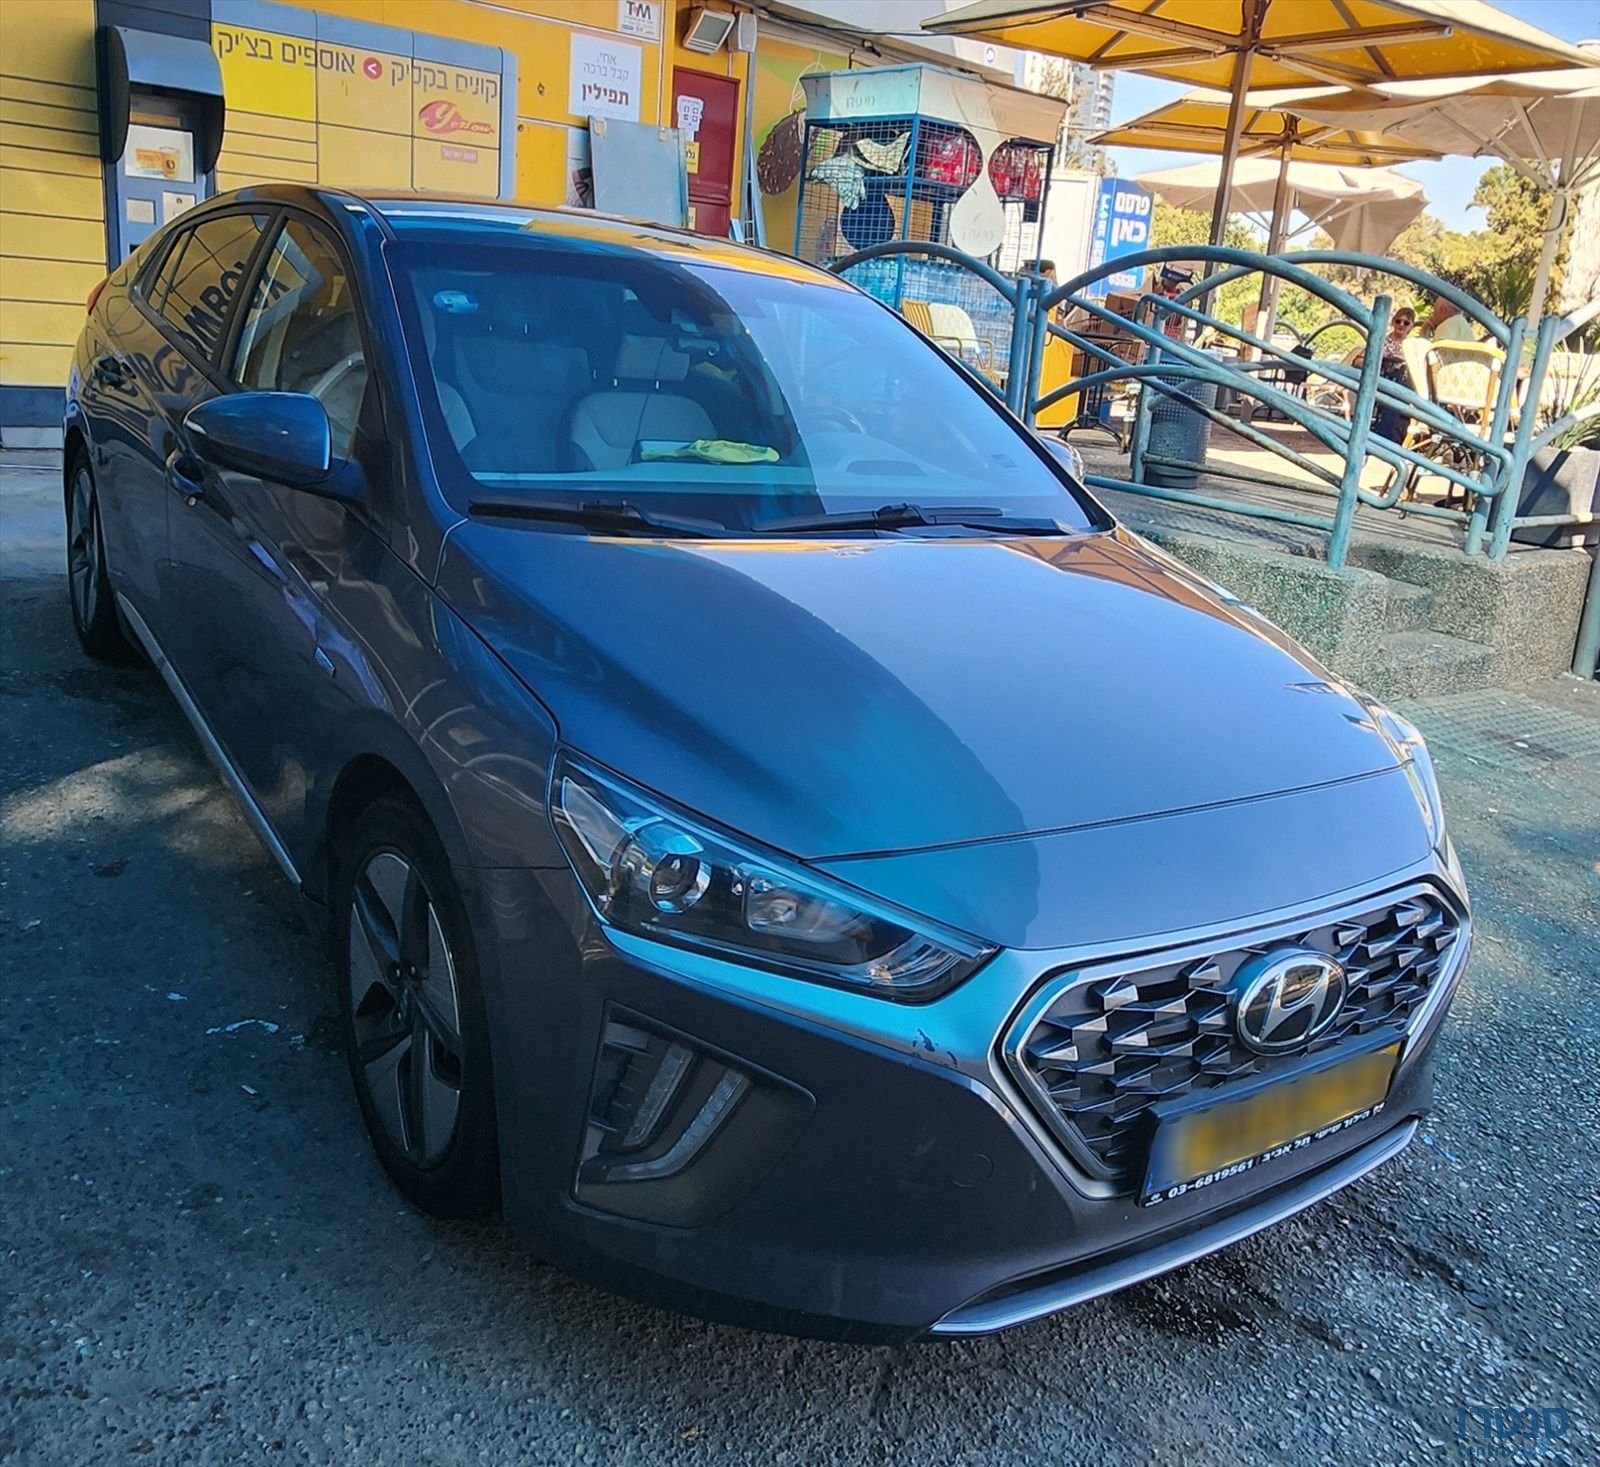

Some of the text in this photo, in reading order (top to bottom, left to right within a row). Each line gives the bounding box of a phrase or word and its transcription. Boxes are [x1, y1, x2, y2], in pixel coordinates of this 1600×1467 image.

[282, 42, 355, 74] אוספים
[391, 61, 449, 93] בקליק
[583, 62, 629, 82] קבל ברכה
[455, 74, 498, 103] קונים
[581, 83, 630, 106] תפילין
[1115, 191, 1150, 216] פרסם
[1110, 218, 1147, 247] כאן
[1294, 1136, 1312, 1149] תל
[1314, 1123, 1342, 1139] שישי
[1262, 1146, 1291, 1163] אביב
[1168, 1159, 1254, 1198] 03-6819561
